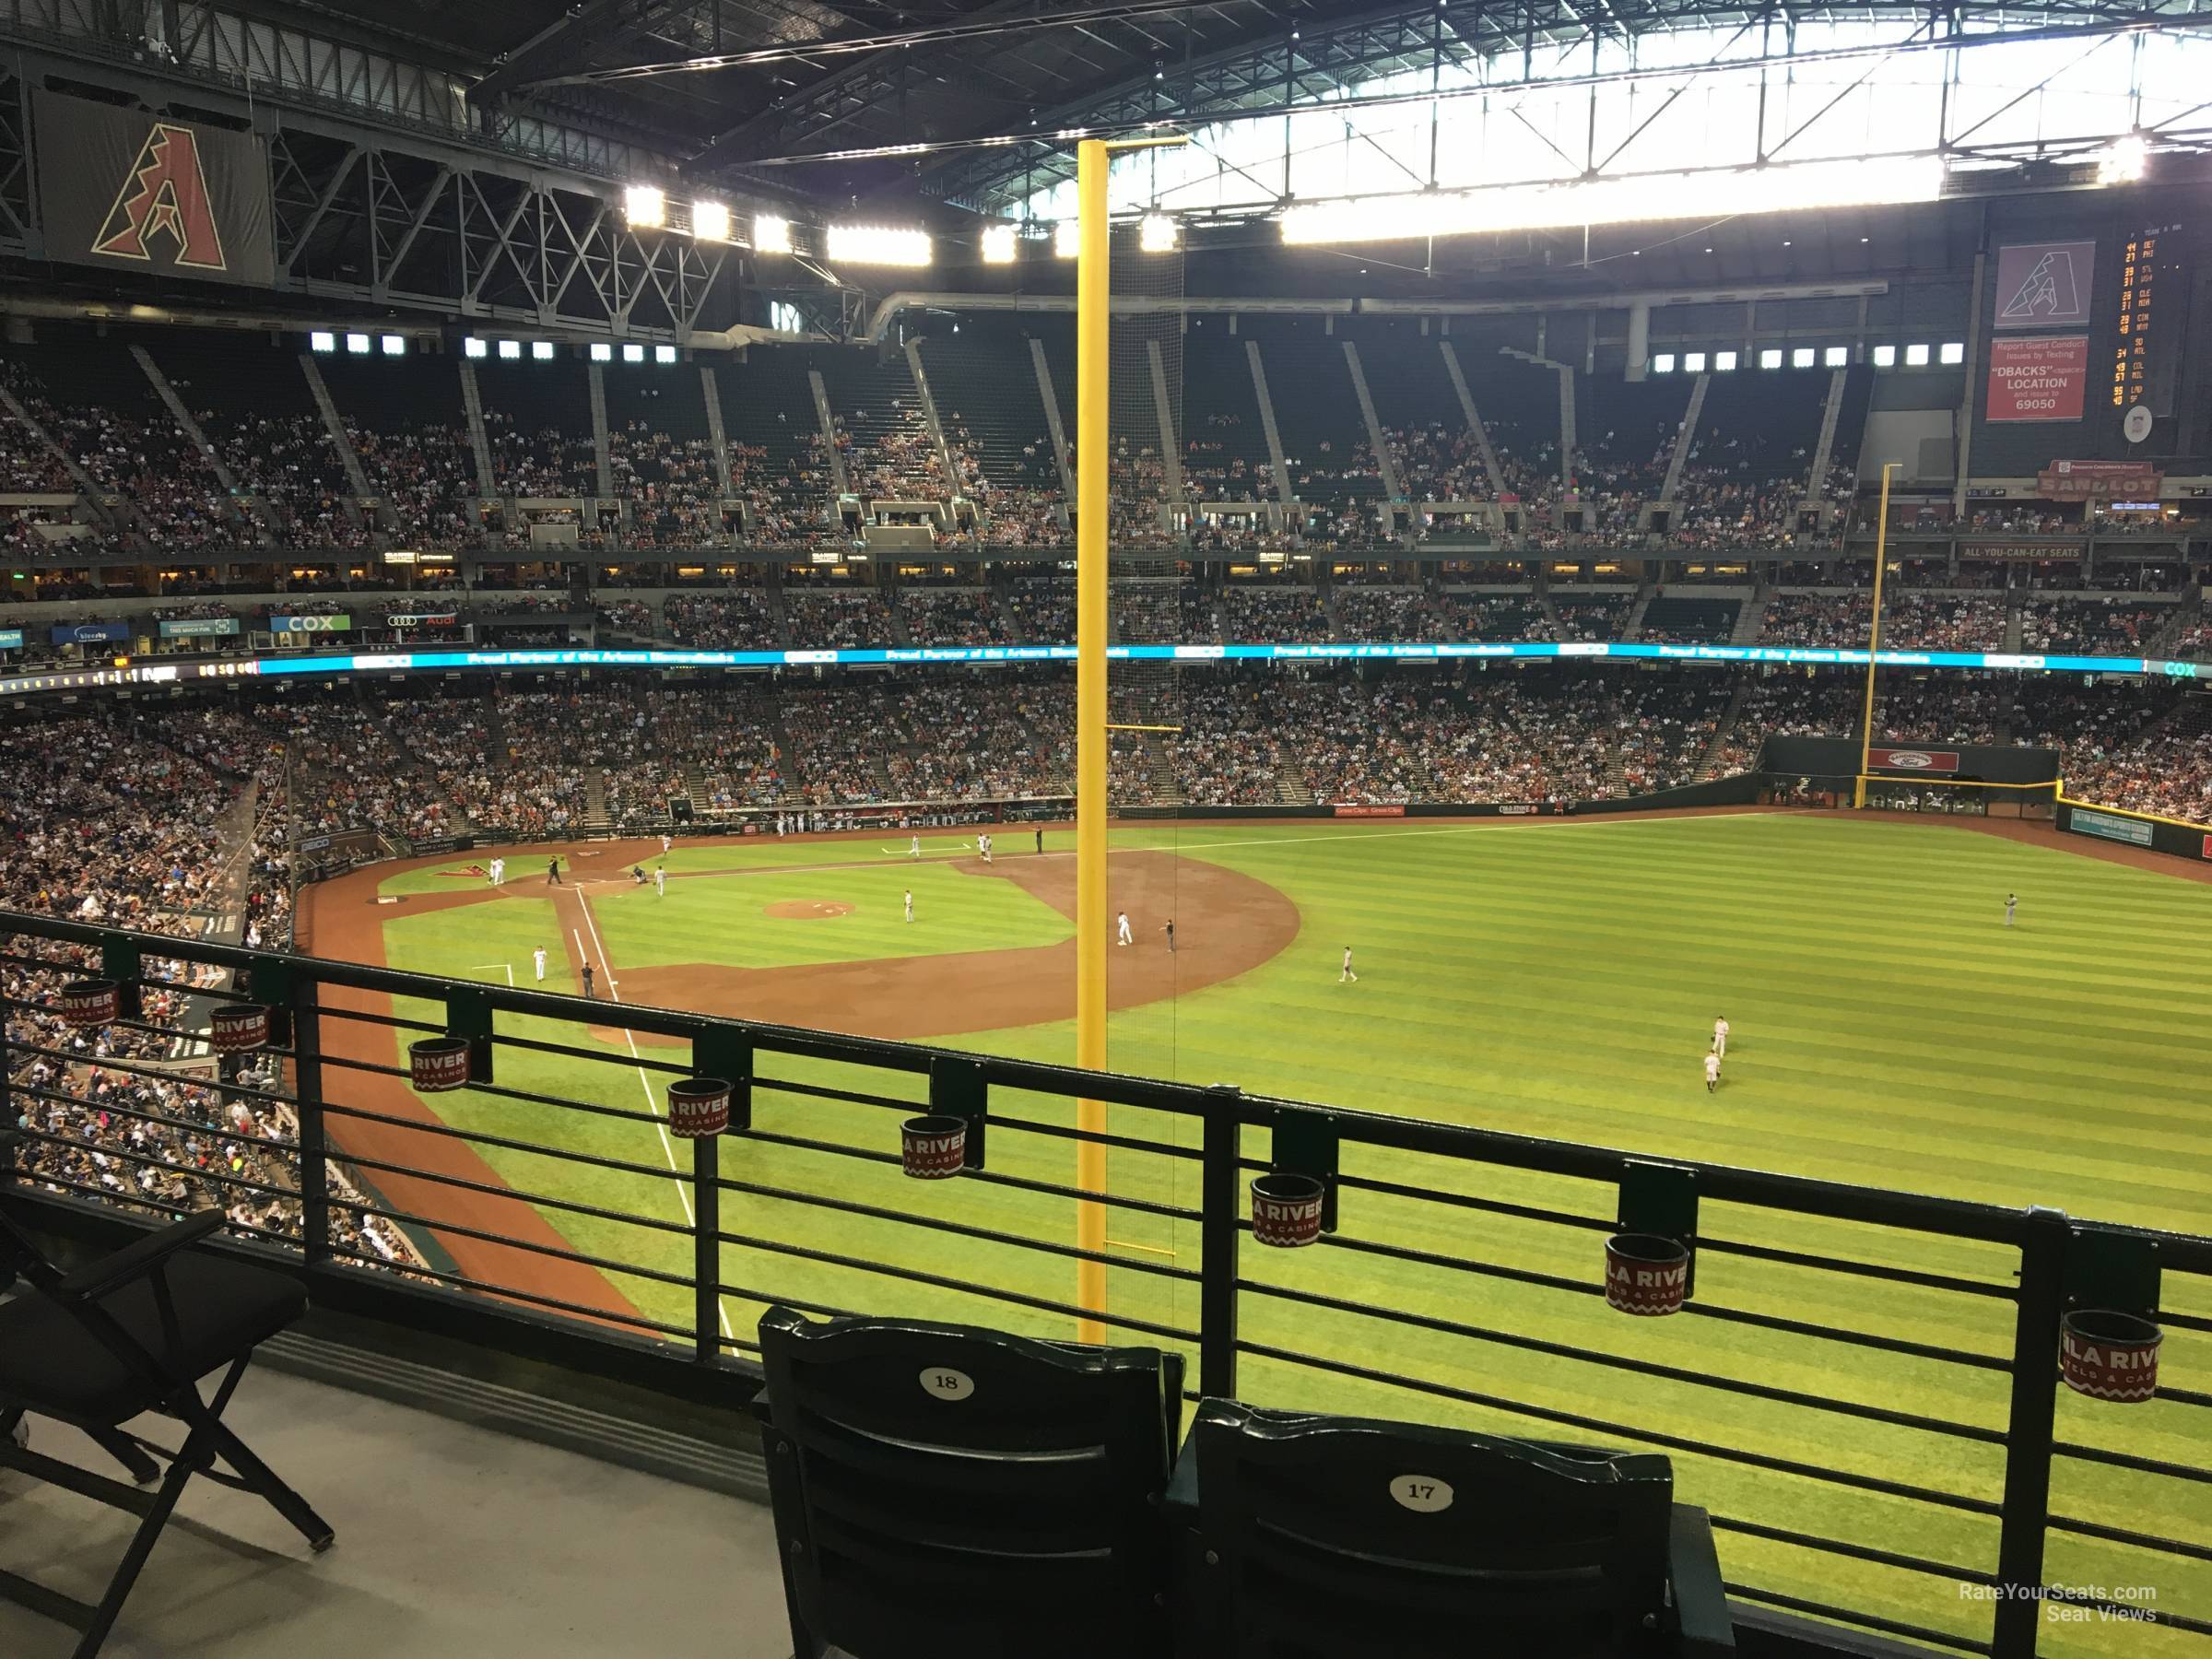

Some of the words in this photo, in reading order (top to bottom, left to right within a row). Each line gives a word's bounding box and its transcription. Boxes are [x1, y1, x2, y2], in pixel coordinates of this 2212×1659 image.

[2143, 250, 2154, 258] PHI
[2026, 342, 2049, 350] Guest
[2051, 340, 2085, 348] Conduct
[2033, 352, 2043, 360] by
[2046, 350, 2075, 359] Texting
[2007, 378, 2067, 389] LOCATION
[2016, 399, 2055, 409] 69050
[2050, 548, 2079, 557] SEATS
[288, 616, 334, 632] COX
[426, 616, 455, 625] Audi
[2164, 662, 2197, 677] COX
[1900, 758, 1920, 766] Ford
[65, 994, 112, 1008] RIVER
[216, 1016, 265, 1033] RIVER
[415, 1053, 465, 1069] RIVER
[678, 1095, 730, 1115] RIVER
[1637, 1265, 1687, 1287] RIVE
[935, 1375, 959, 1390] 18
[1409, 1484, 1435, 1500] 17
